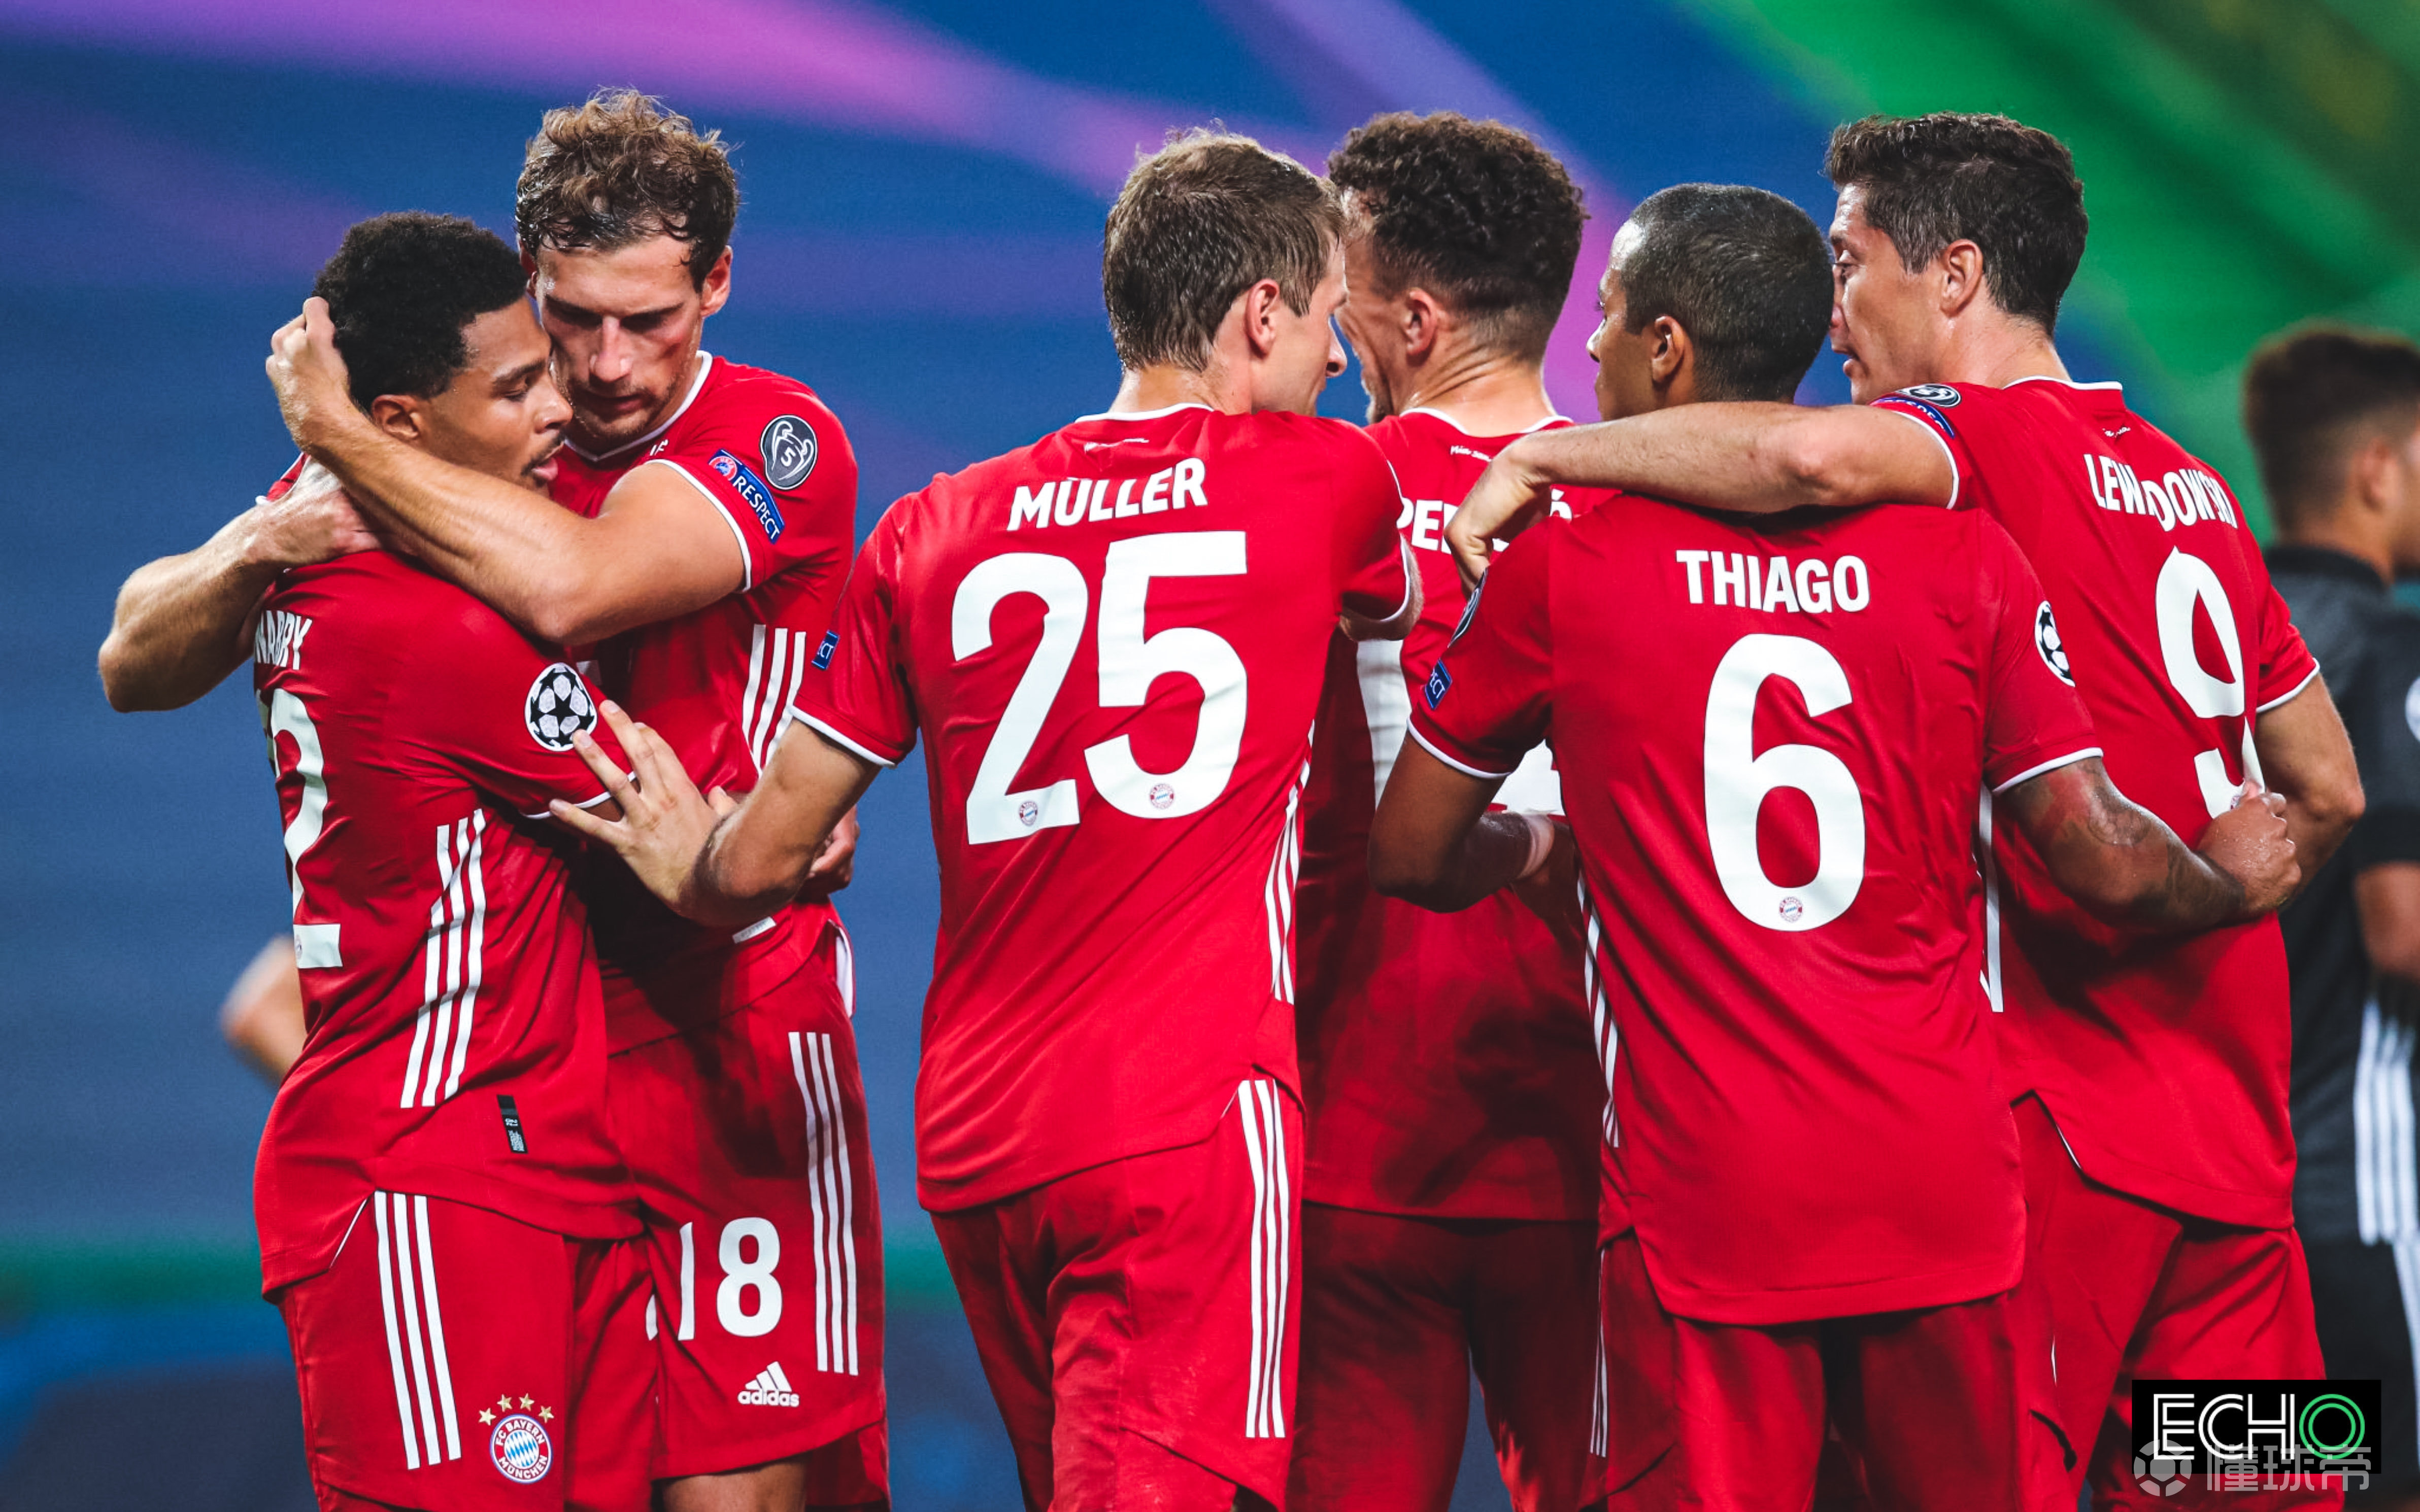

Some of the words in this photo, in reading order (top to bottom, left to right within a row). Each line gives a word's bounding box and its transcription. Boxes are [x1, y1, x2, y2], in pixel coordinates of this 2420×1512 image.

[781, 446, 796, 467] 5
[732, 475, 780, 539] RESPECT
[1006, 457, 1208, 531] MÜLLER
[2083, 454, 2238, 532] LEWDOWSKI
[1676, 549, 1870, 613] THIAGO
[255, 610, 313, 670] NABRY
[951, 530, 1248, 845] 25
[1703, 633, 1865, 932] 6
[678, 1217, 783, 1341] 18
[737, 1388, 799, 1407] adidas
[495, 1429, 507, 1446] FC
[505, 1420, 545, 1444] BAYERN
[498, 1454, 548, 1479] MÜNCHEN
